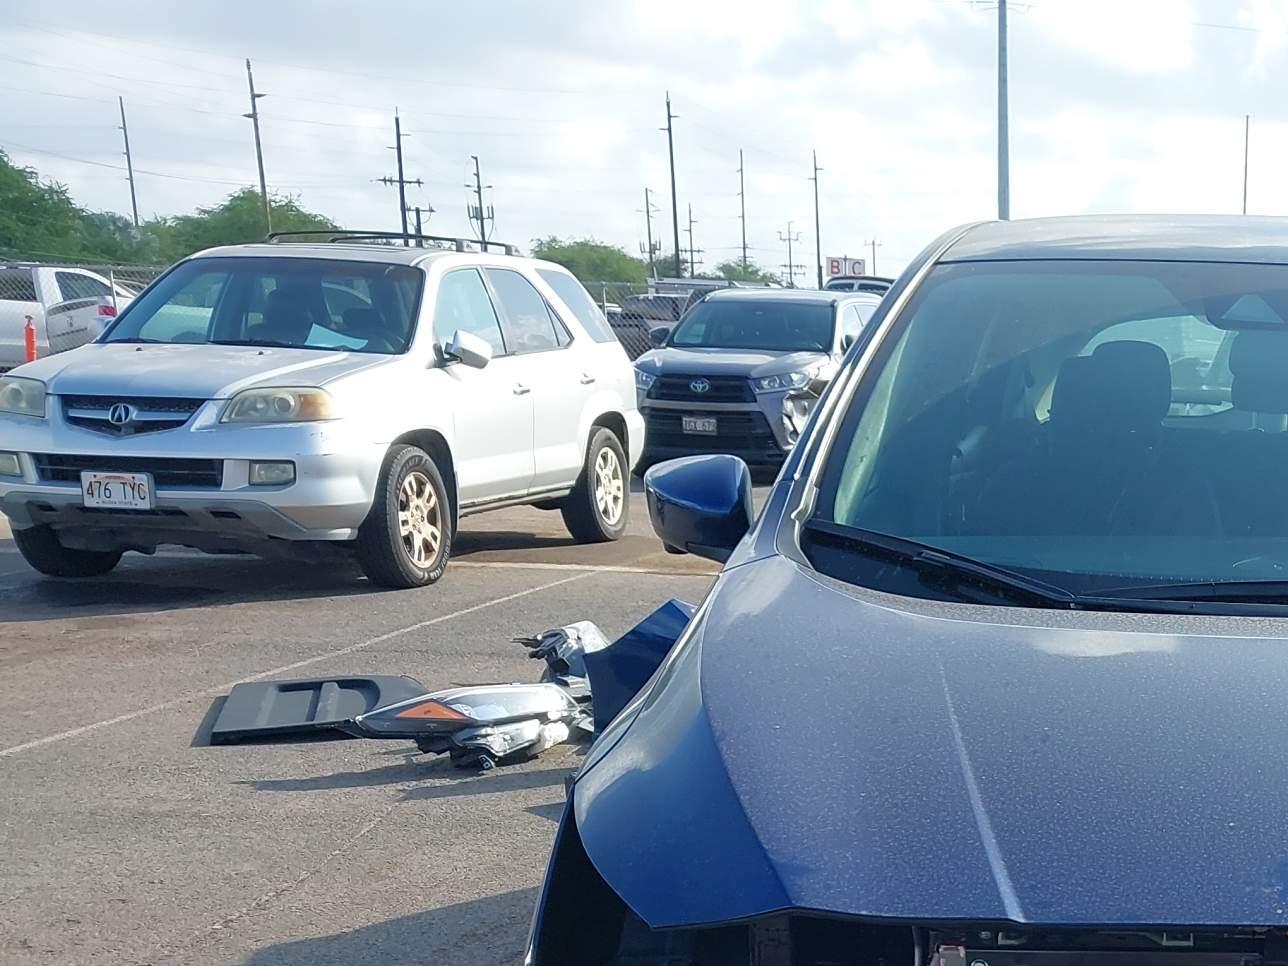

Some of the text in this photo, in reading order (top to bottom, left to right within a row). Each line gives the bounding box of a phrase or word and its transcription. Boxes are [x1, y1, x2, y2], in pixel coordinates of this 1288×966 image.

[830, 260, 861, 275] B C
[86, 480, 112, 499] 476
